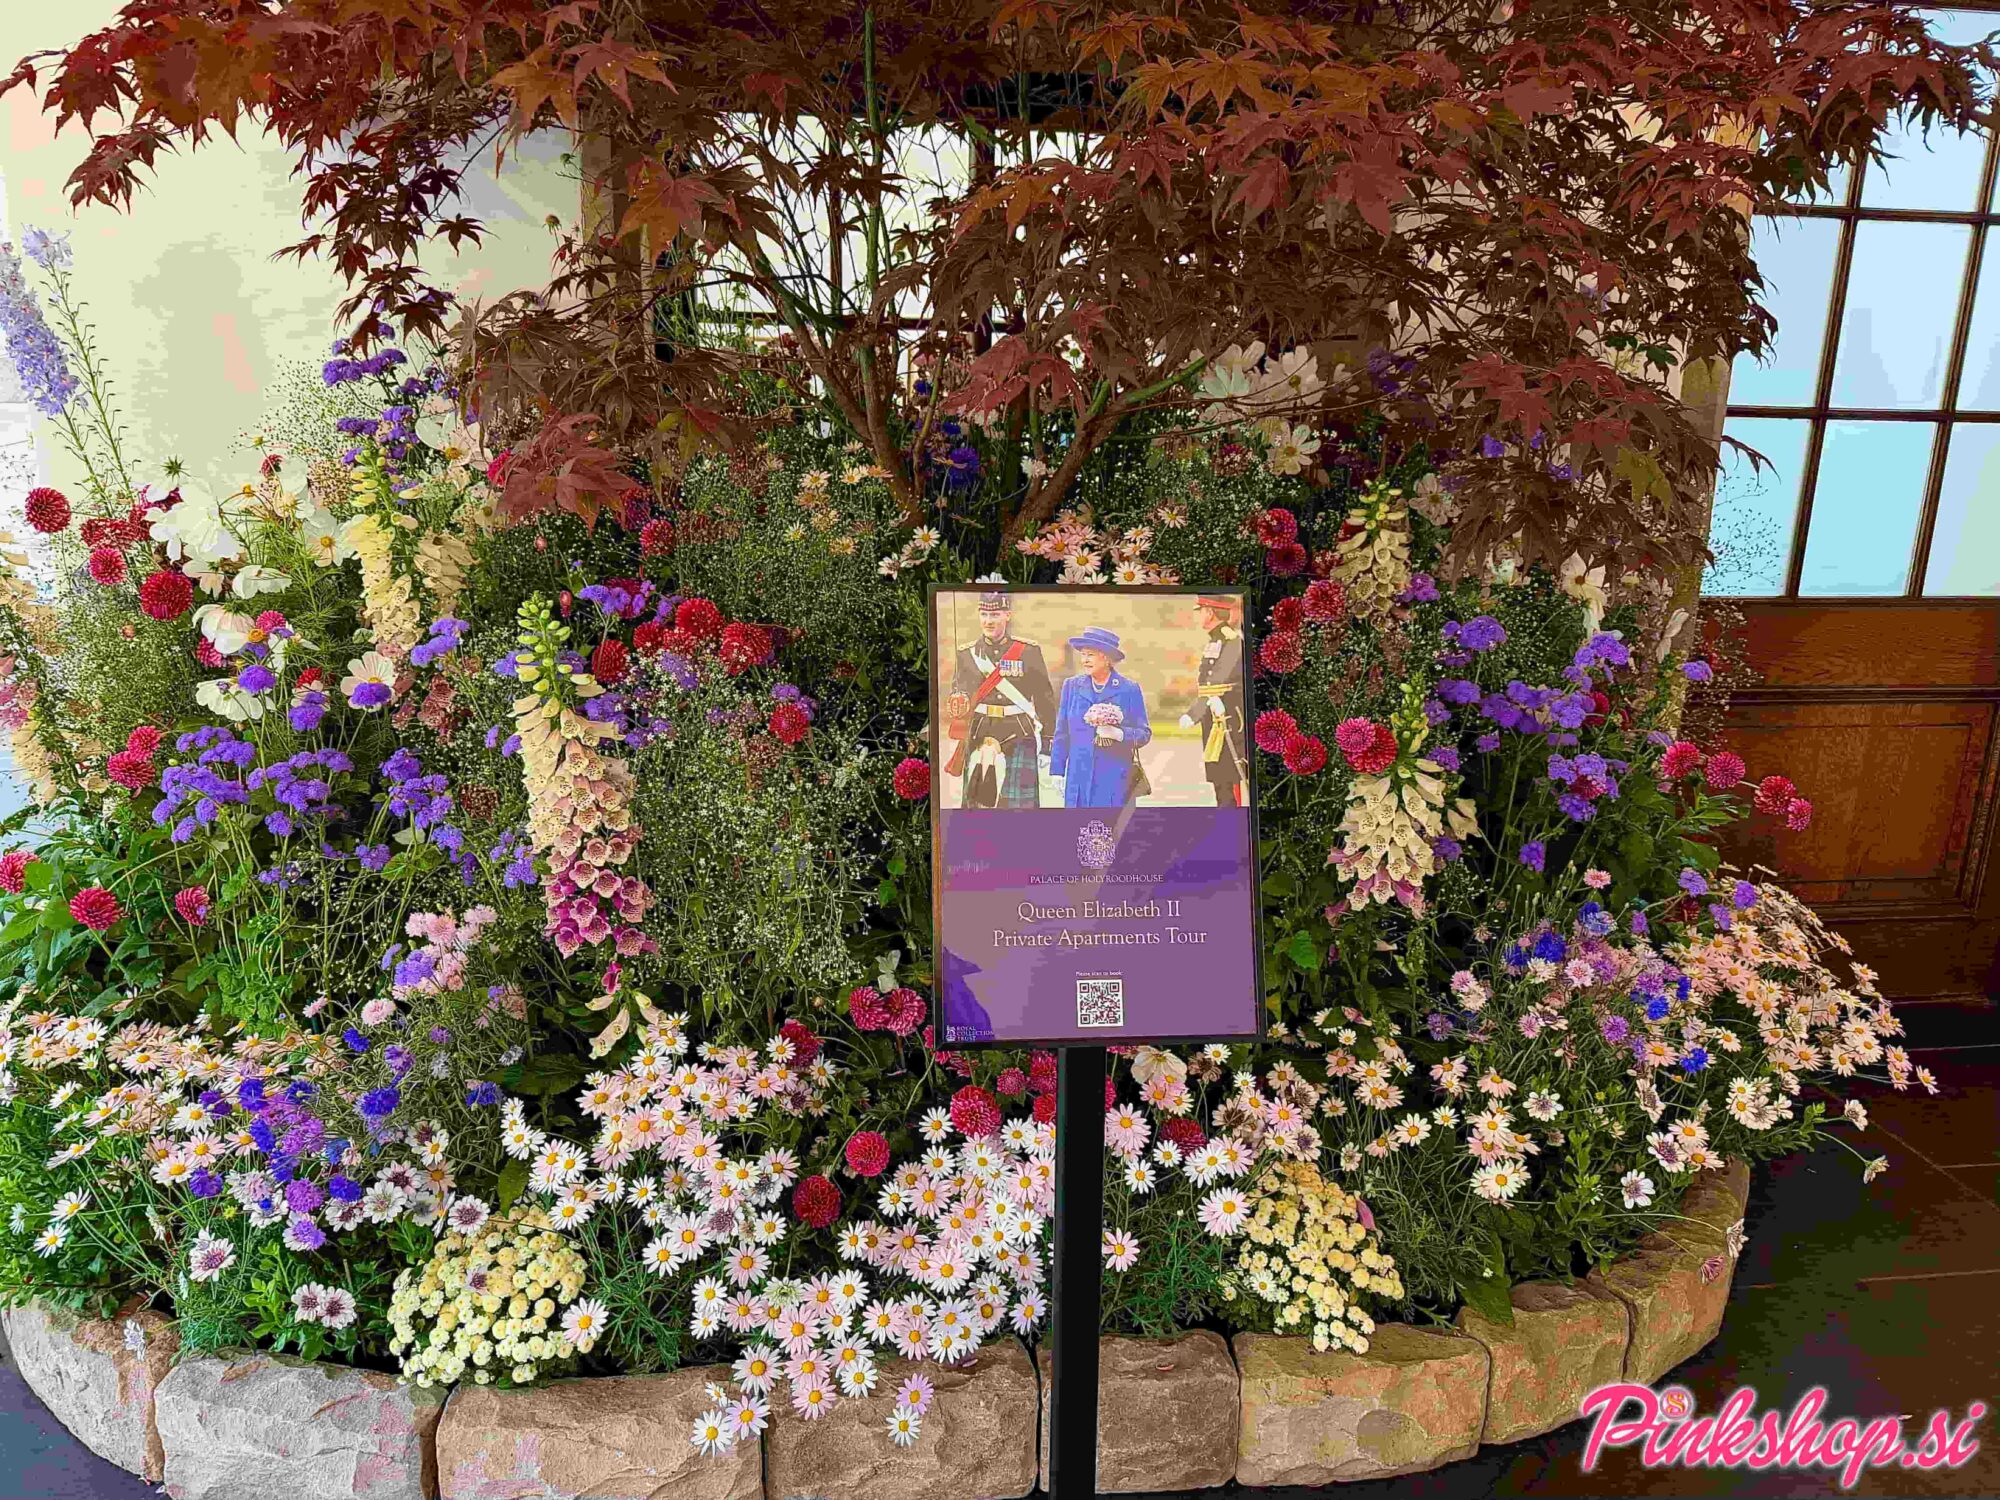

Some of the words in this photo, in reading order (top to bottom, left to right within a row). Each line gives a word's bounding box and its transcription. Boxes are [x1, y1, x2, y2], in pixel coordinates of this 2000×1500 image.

[1030, 875, 1065, 884] PALACE
[1066, 875, 1079, 884] OF
[1081, 874, 1164, 883] HOLYROODHOUSE
[1017, 902, 1077, 922] Queen
[1083, 900, 1161, 918] Elizabeth
[1167, 900, 1181, 917] II
[993, 929, 1053, 947] Private
[1057, 928, 1161, 949] Apartments
[1165, 926, 1208, 944] Tour
